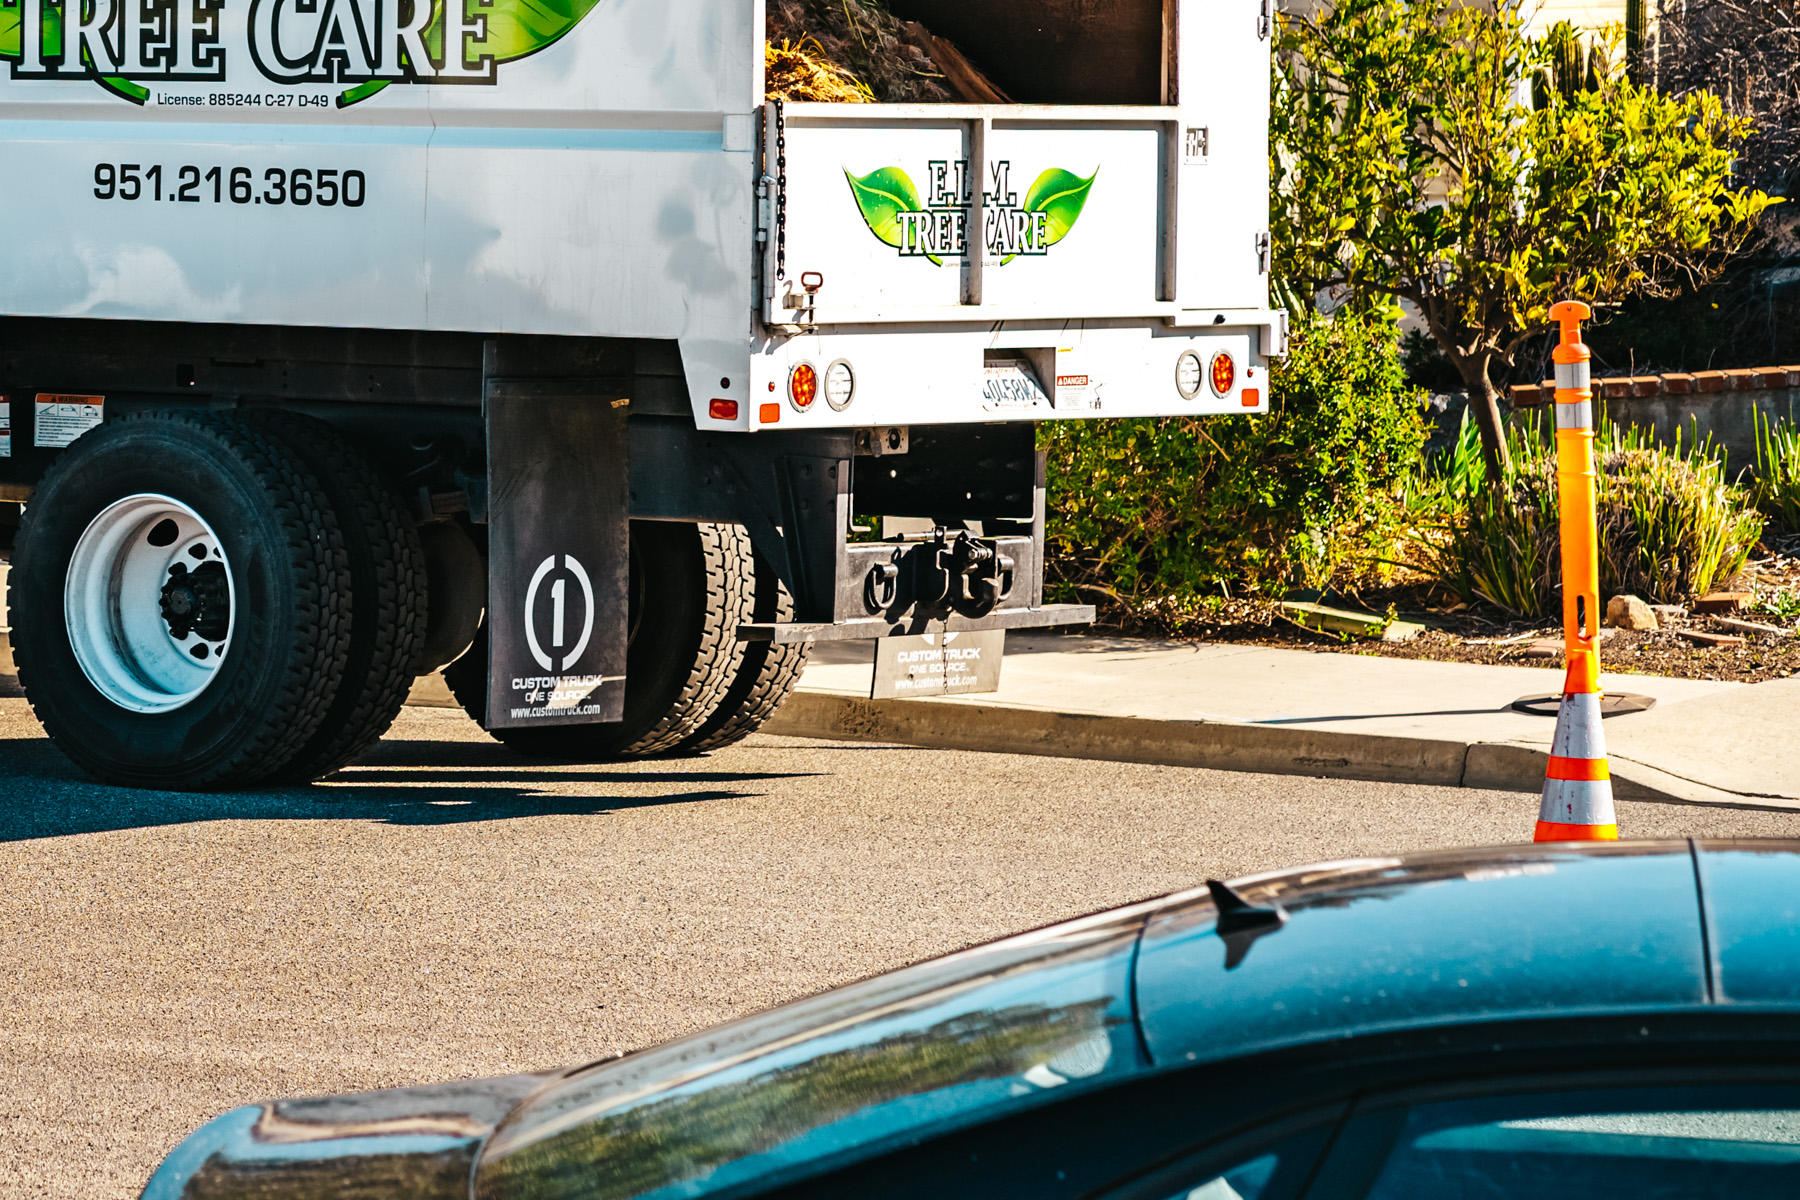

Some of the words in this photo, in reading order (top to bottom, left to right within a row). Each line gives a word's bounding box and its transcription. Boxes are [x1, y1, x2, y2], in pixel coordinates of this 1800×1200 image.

[157, 93, 206, 106] License:
[208, 93, 262, 106] 885244
[265, 94, 294, 107] C-27
[298, 94, 329, 107] D-49
[93, 163, 366, 207] 951.216.3650
[896, 209, 967, 257] TREE
[1063, 376, 1087, 386] DANGER
[897, 649, 942, 663] CUSTOM
[512, 676, 561, 690] CUSTOM
[562, 674, 603, 688] TRUCK
[525, 691, 545, 702] ONE
[511, 704, 601, 719] www.customtruck.com
